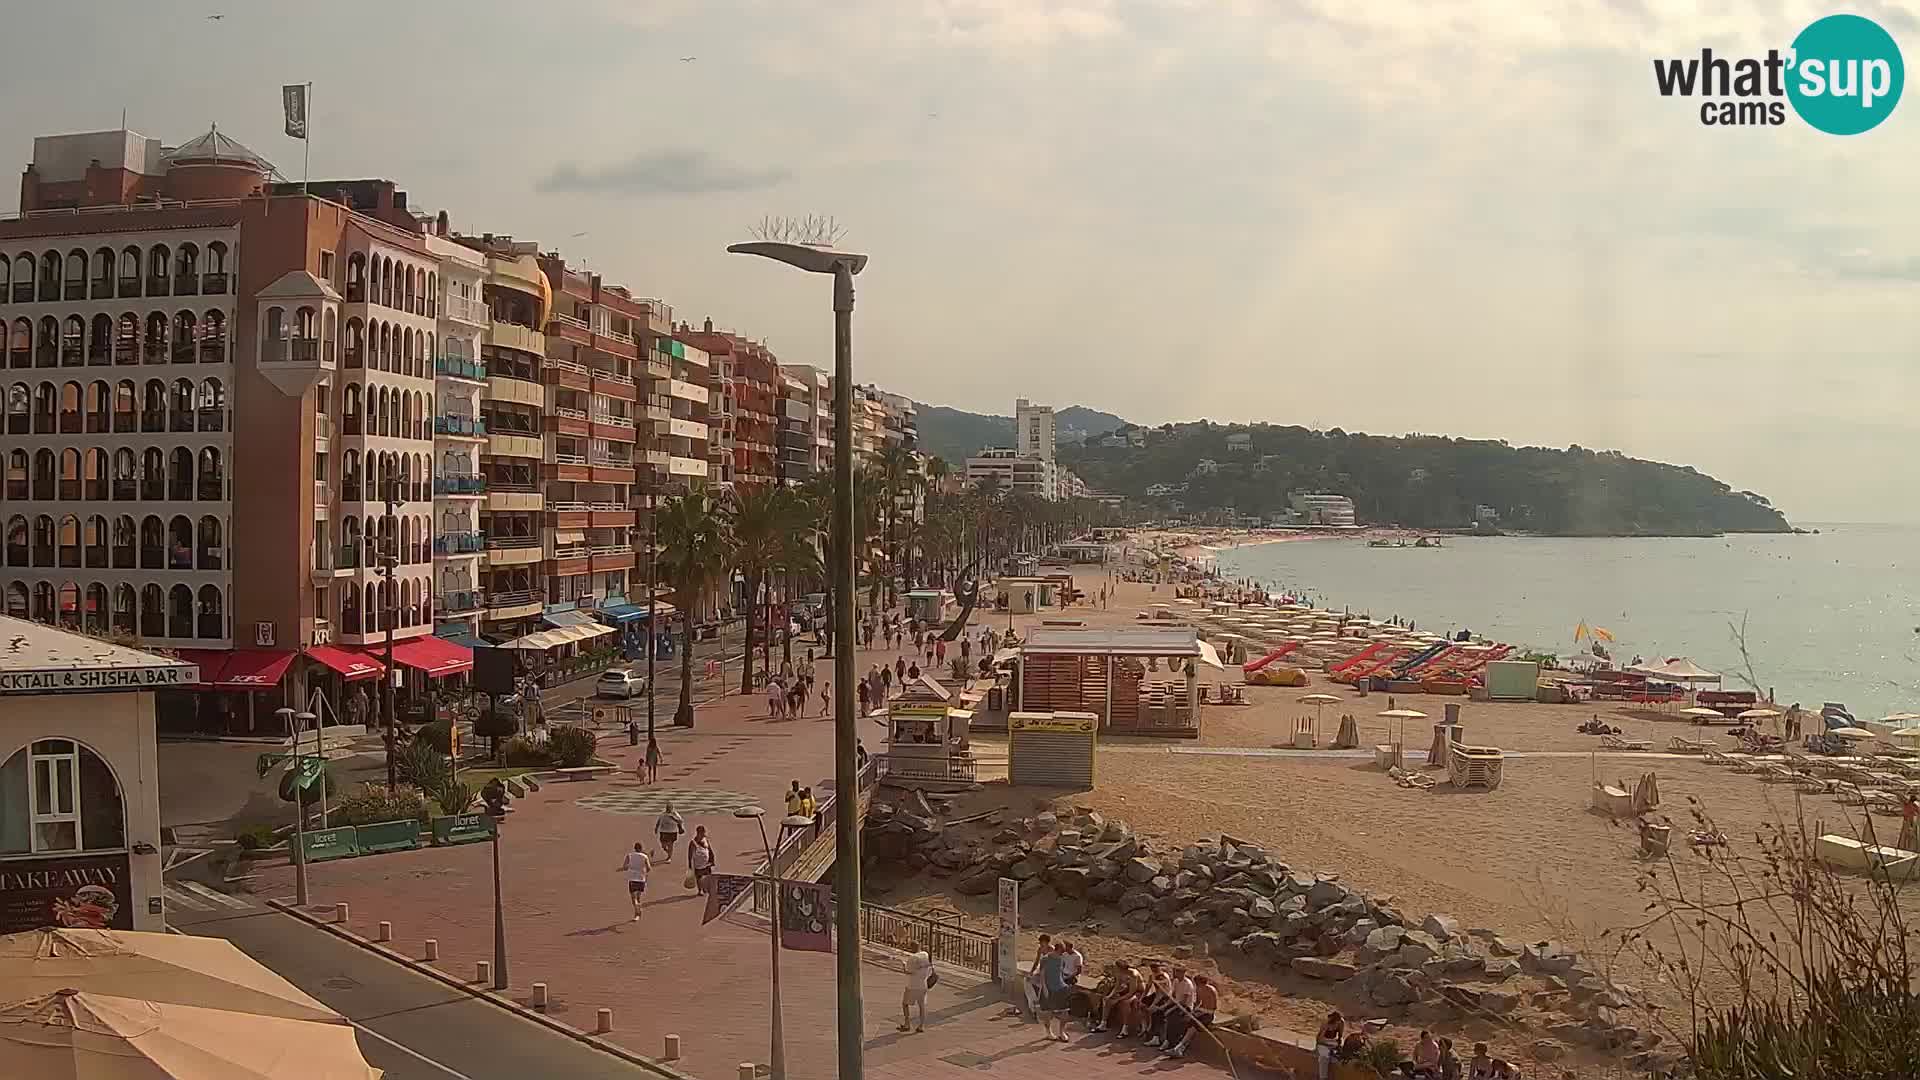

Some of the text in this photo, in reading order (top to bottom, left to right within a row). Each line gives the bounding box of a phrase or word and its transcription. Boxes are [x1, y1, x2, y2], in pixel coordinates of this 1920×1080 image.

[63, 673, 74, 686] &
[79, 671, 140, 686] SHISHA
[145, 669, 178, 683] BAR
